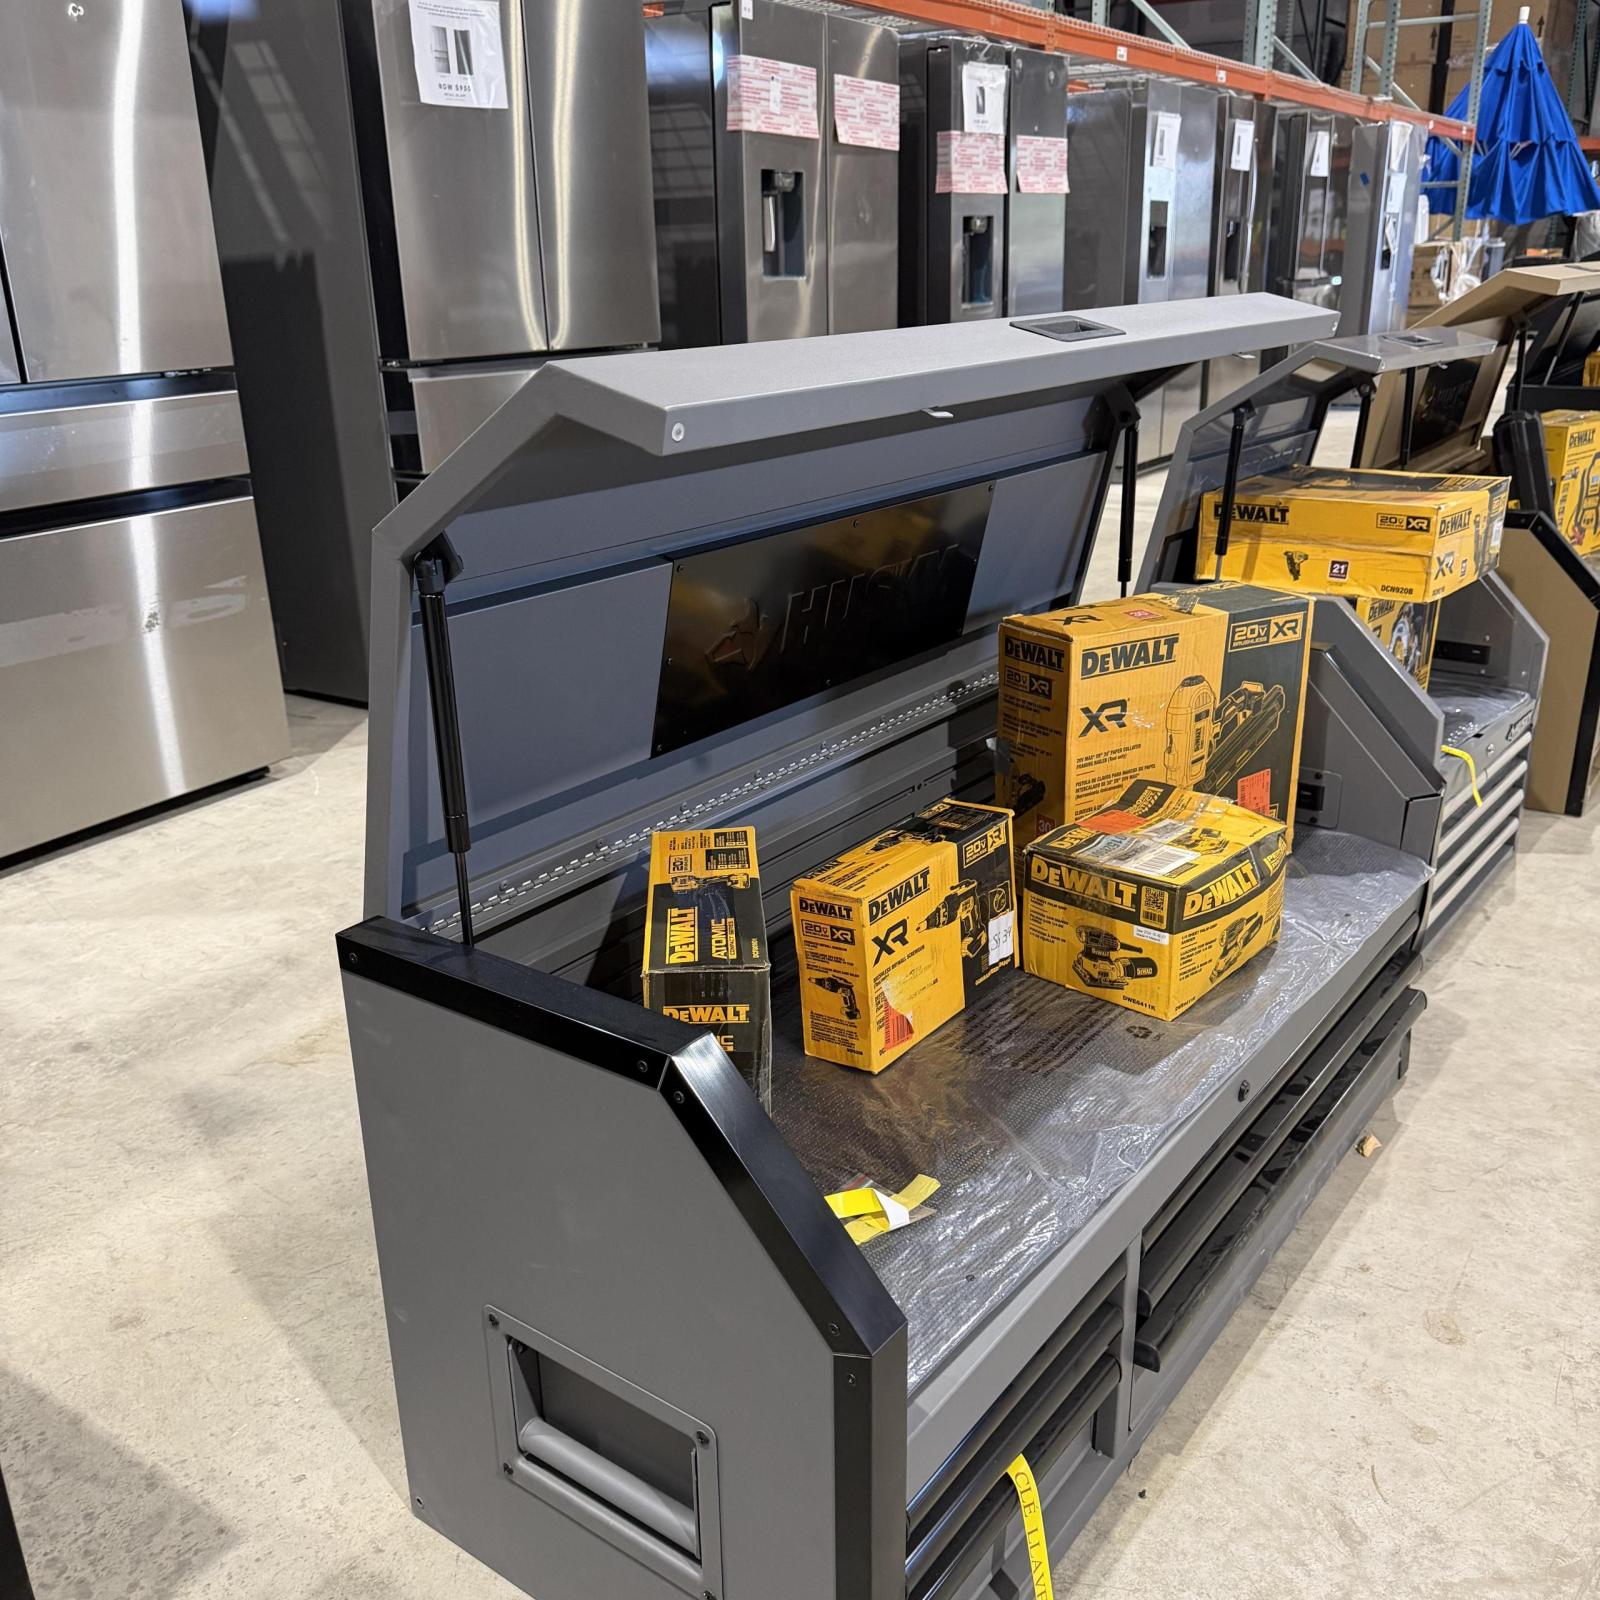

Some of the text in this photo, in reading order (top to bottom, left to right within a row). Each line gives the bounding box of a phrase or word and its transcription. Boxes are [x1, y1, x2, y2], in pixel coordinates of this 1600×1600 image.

[1568, 428, 1595, 449] DEWALT
[1407, 517, 1428, 530] XR
[1440, 509, 1472, 537] DEWALT
[1380, 584, 1414, 595] DCN920B
[1272, 618, 1299, 639] XR
[1004, 636, 1065, 672] DEWALT
[1080, 635, 1180, 678] DEWALT
[1030, 677, 1050, 696] XR
[1078, 698, 1129, 738] XR
[1111, 771, 1122, 779] PARA
[868, 867, 930, 924] DEWALT
[1030, 856, 1137, 910] DEWALT
[1183, 861, 1259, 919] DEWALT
[799, 898, 853, 921] DEWALT
[669, 908, 696, 964] DEWALT
[710, 918, 728, 960] ATOMIC
[831, 928, 852, 942] XR
[871, 918, 909, 968] XR
[1014, 1471, 1040, 1518] CLÉ
